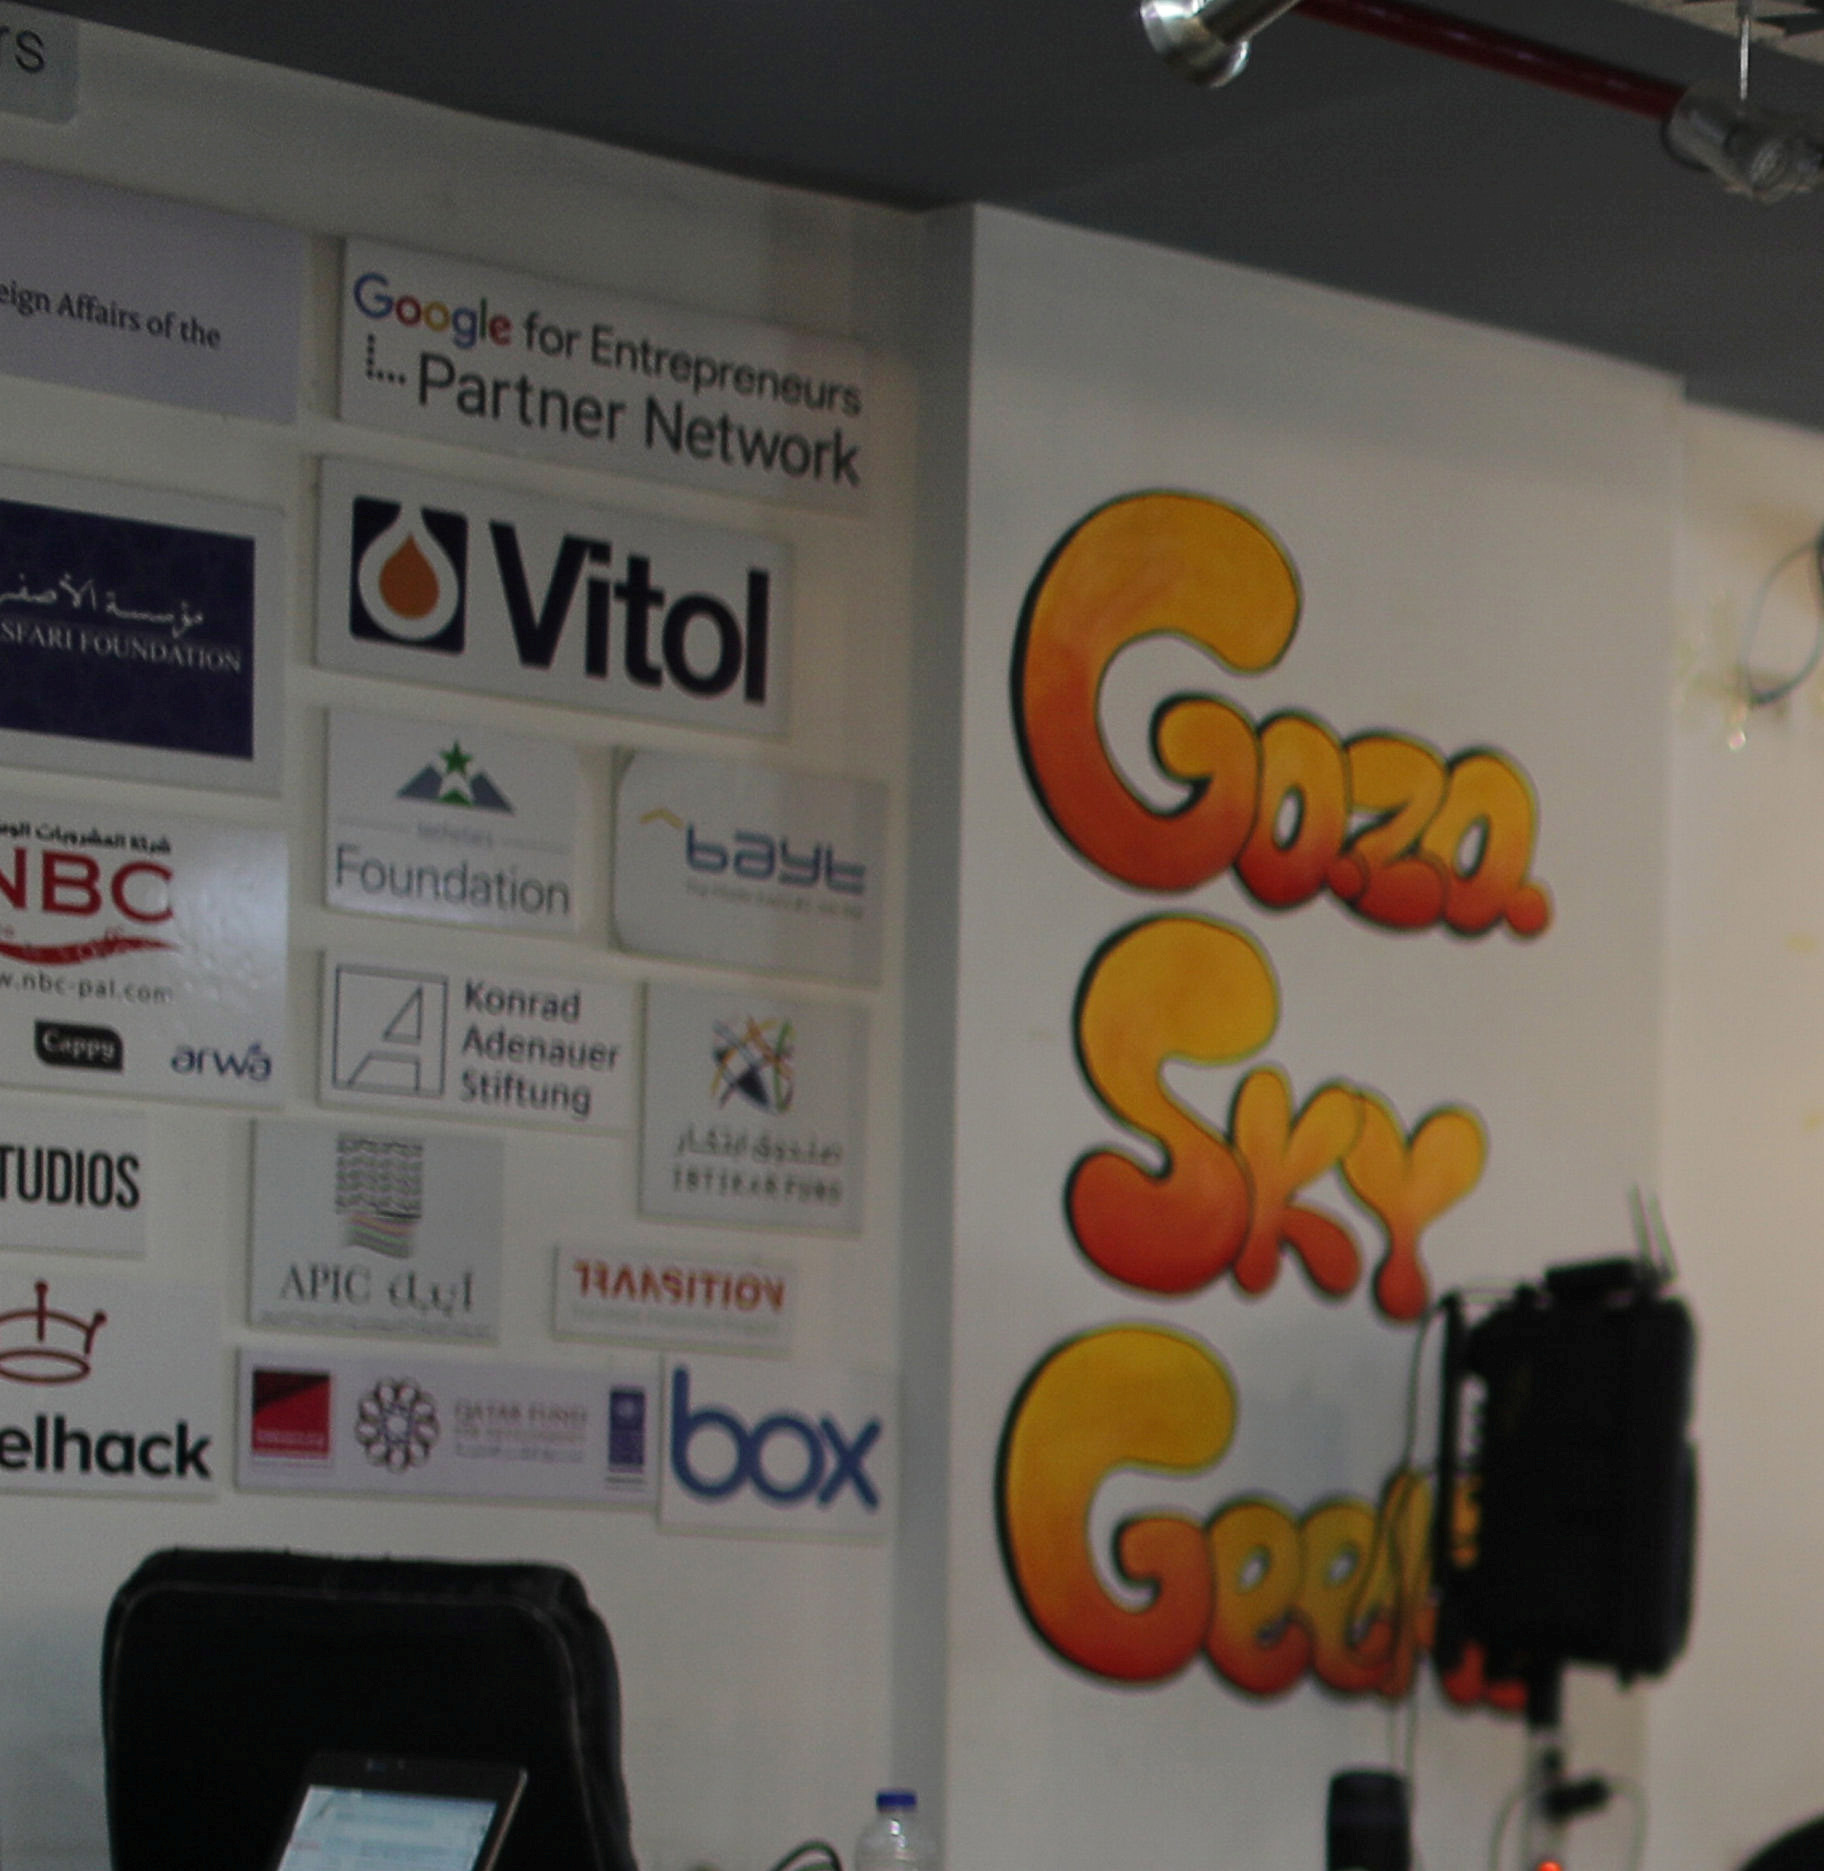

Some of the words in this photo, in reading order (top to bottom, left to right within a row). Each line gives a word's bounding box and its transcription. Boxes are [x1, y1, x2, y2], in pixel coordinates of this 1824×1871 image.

[57, 291, 141, 332] Affairs
[147, 311, 175, 338] of
[180, 316, 222, 349] the
[354, 272, 513, 349] Google
[523, 311, 582, 359] for
[590, 323, 863, 417] Entrepreneurs
[417, 352, 627, 441] Partner
[643, 395, 861, 487] Network
[489, 519, 770, 705] Vitol
[80, 630, 242, 666] FOUNDATION
[336, 842, 570, 916] Foundation
[464, 978, 581, 1024] Konrad
[42, 1027, 117, 1064] Cappy
[461, 1023, 621, 1071] Adenauer
[460, 1066, 592, 1123] Stiftung
[281, 1263, 371, 1305] APIC
[0, 1413, 213, 1479] elhack
[670, 1363, 881, 1512] box
